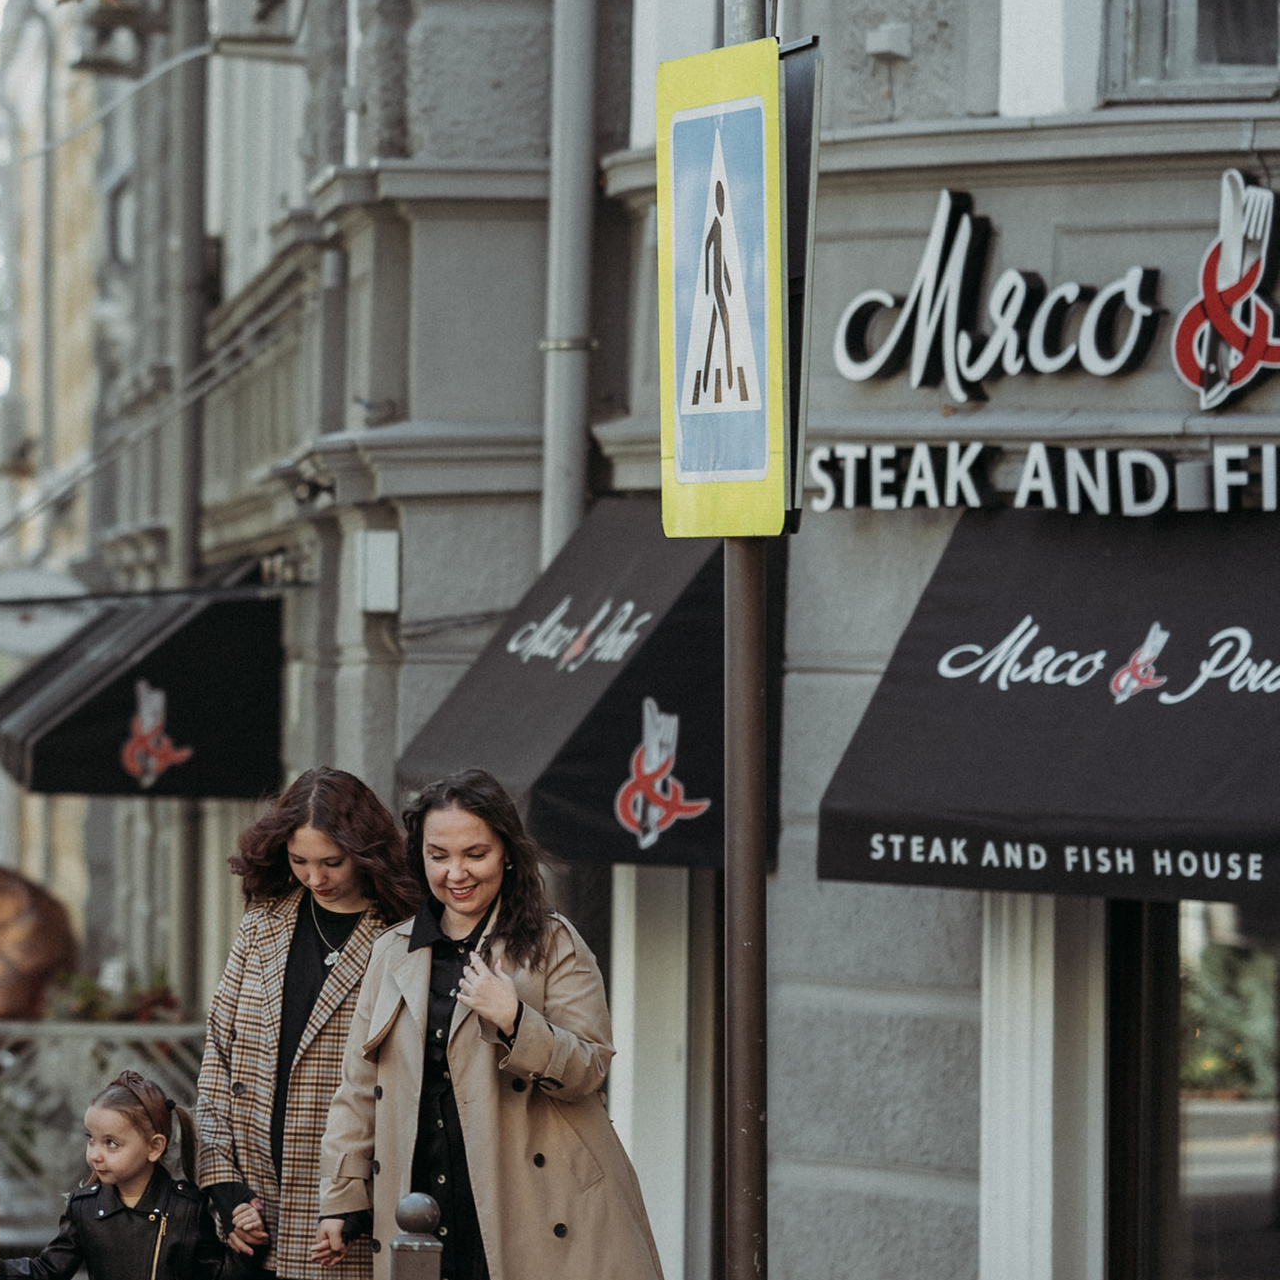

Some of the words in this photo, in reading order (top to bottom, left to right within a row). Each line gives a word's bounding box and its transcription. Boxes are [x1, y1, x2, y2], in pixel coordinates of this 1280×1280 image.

[833, 188, 1154, 403] Мясо
[809, 442, 984, 513] STEAK
[1013, 442, 1170, 517] AND
[936, 614, 1108, 691] Мясо
[869, 833, 969, 866] STEAK
[980, 840, 1048, 871] AND
[1063, 845, 1135, 875] FISH
[1152, 849, 1263, 881] HOUSE
